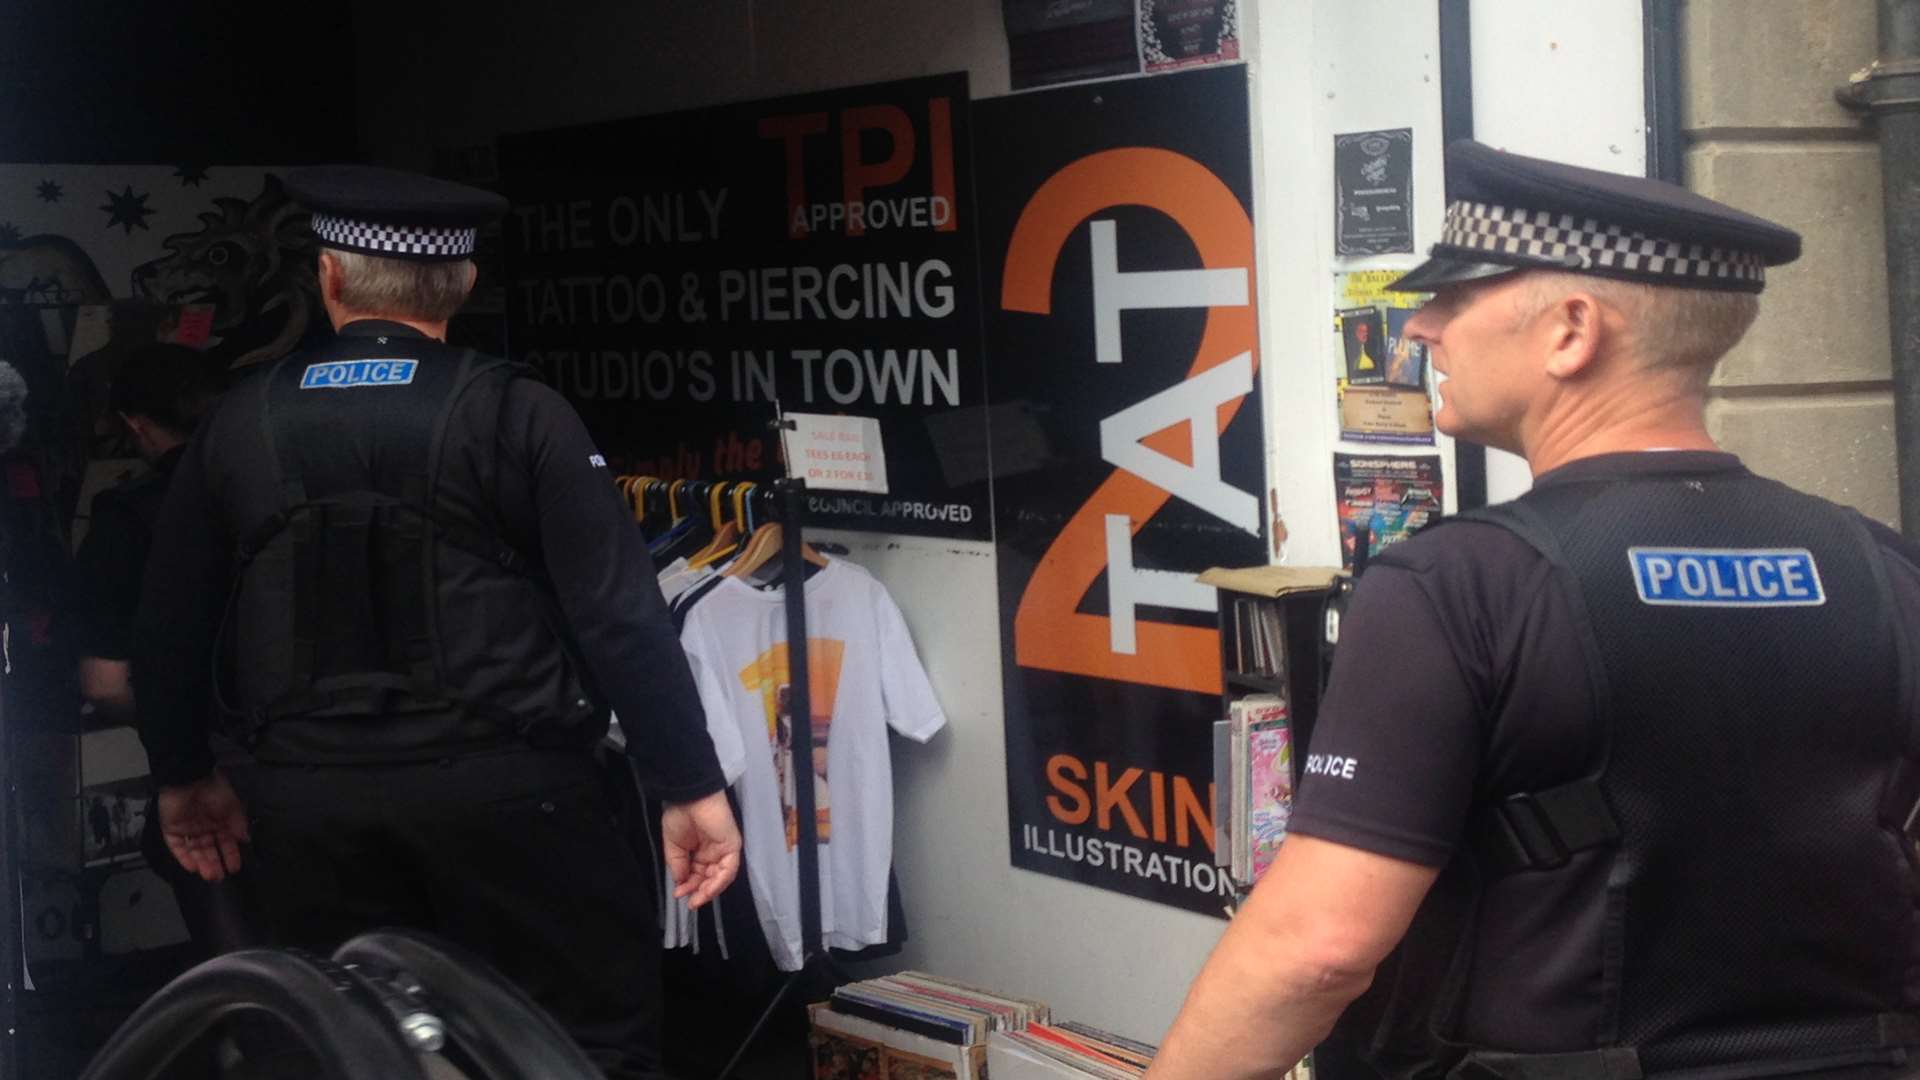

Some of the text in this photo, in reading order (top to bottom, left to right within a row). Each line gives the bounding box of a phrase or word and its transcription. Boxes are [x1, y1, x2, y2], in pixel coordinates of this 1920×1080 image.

[758, 97, 957, 239] TPI
[514, 188, 729, 254] THE ONLY
[791, 196, 951, 234] APPROVED
[518, 259, 955, 325] TATTOO & PIERCING
[310, 362, 406, 384] POLICE
[732, 351, 777, 401] IN
[791, 348, 960, 407] TOWN
[1090, 219, 1261, 655] TAT
[881, 501, 973, 523] APPROVED
[1645, 556, 1810, 599] POLICE
